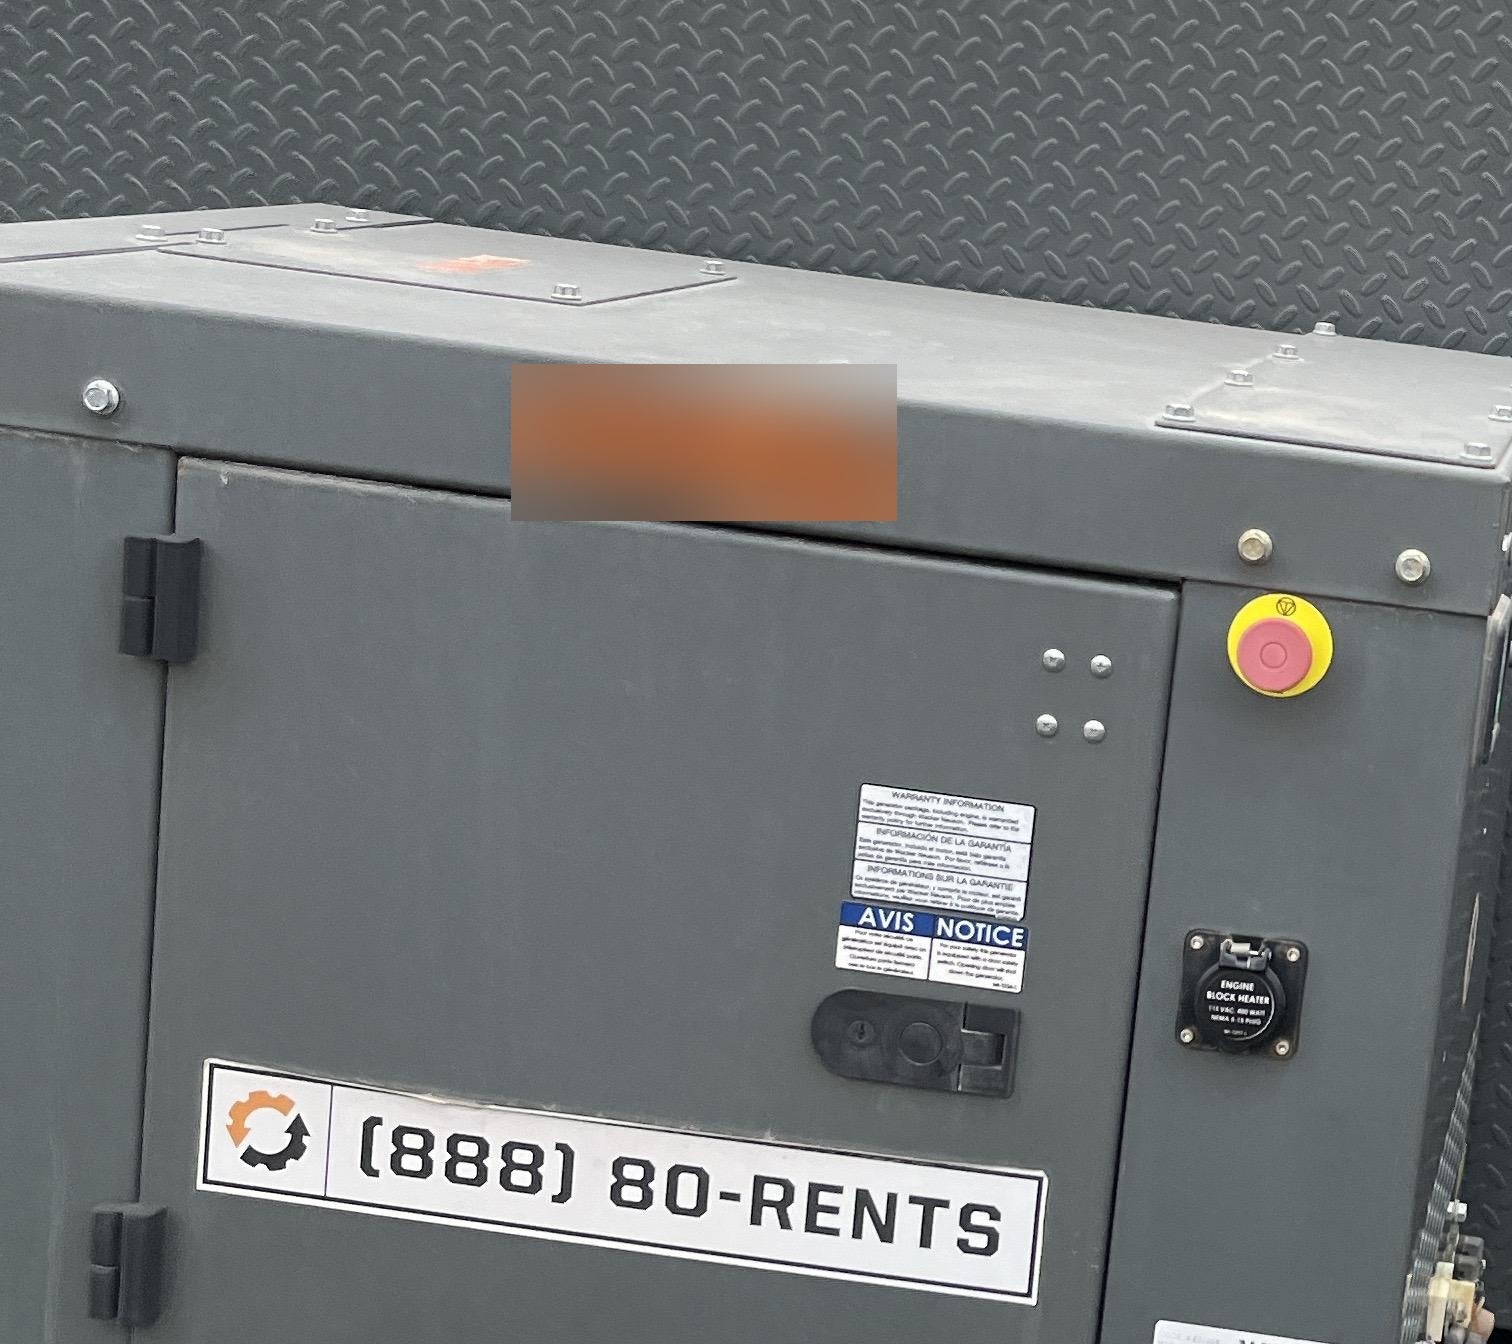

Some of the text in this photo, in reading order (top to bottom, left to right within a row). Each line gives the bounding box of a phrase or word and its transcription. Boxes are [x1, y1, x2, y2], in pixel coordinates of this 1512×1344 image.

[955, 839, 966, 847] LA
[957, 877, 967, 885] LA
[858, 907, 914, 932] AVIS
[937, 917, 1024, 948] NOTICE
[1221, 980, 1254, 991] ENGINE
[1206, 990, 1270, 1004] BLOCK HEATER
[361, 1115, 1002, 1258] (888) 80-RENTS
